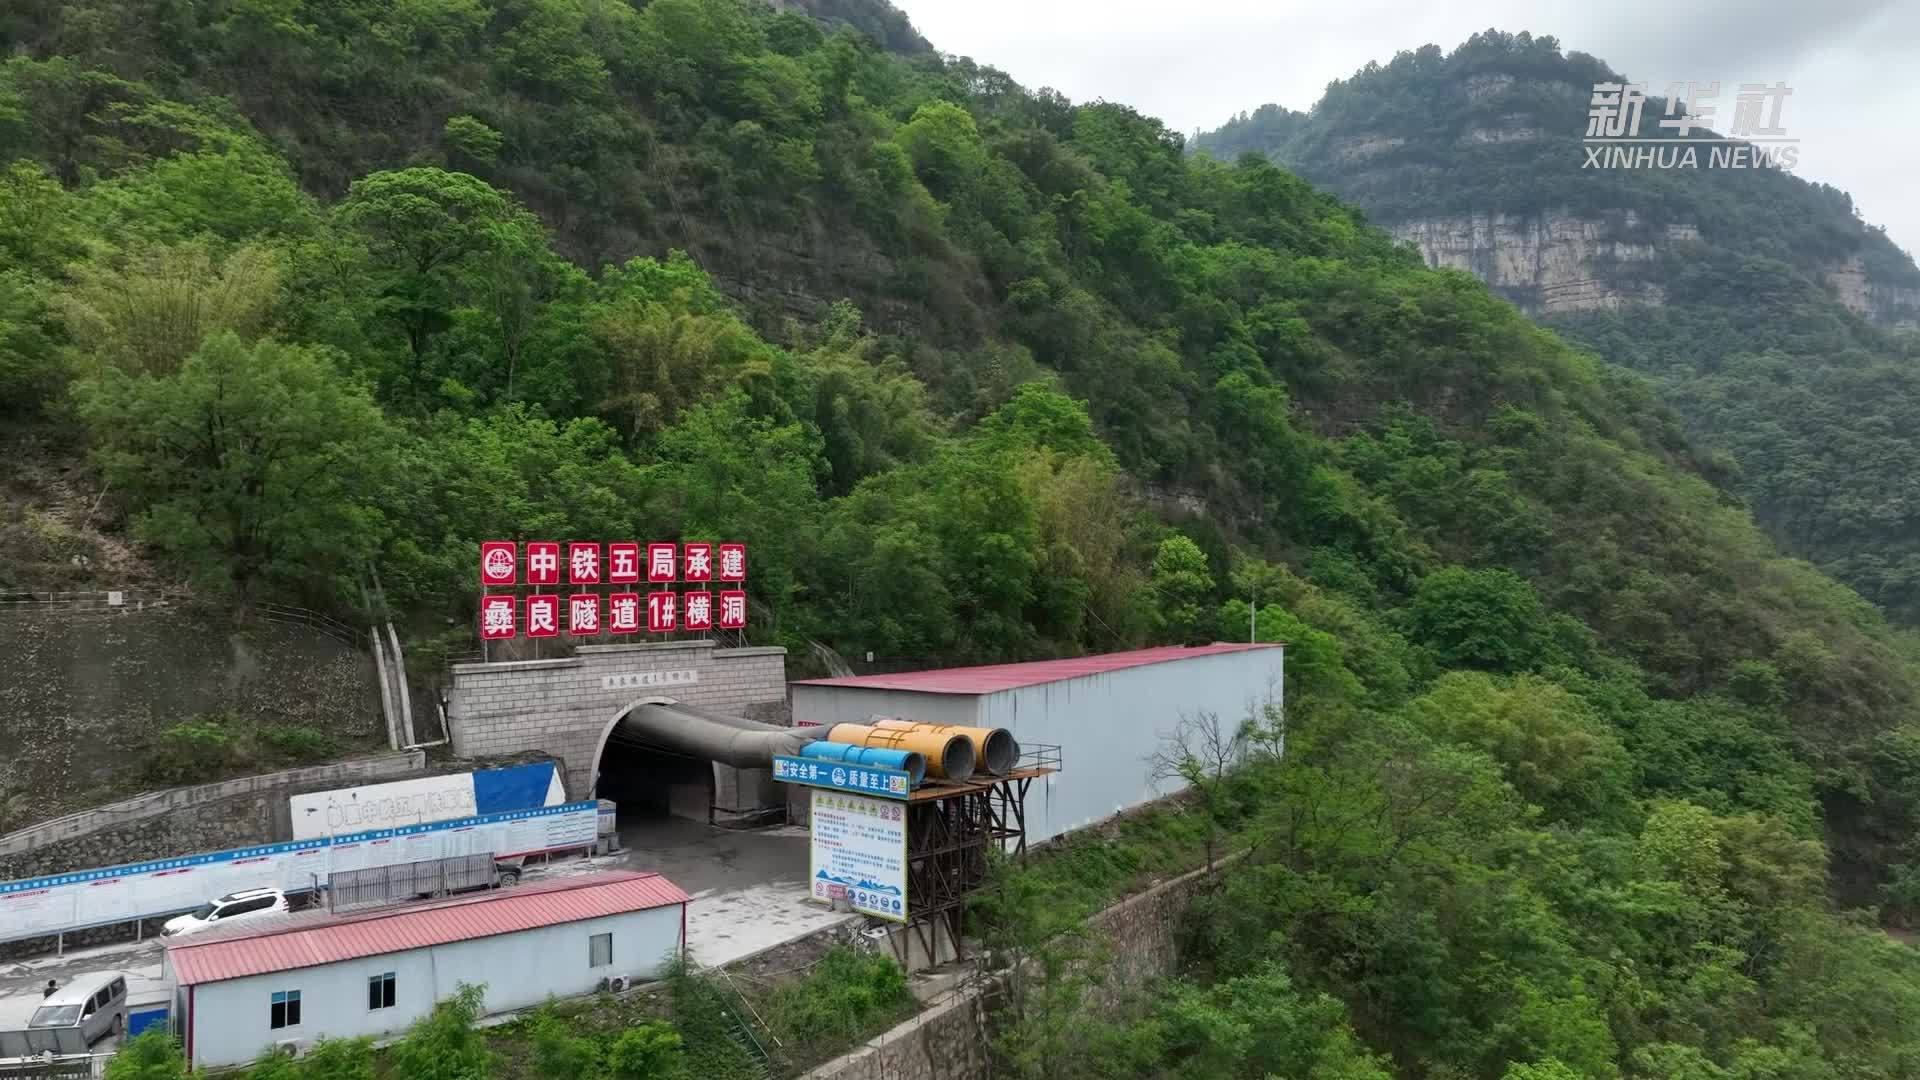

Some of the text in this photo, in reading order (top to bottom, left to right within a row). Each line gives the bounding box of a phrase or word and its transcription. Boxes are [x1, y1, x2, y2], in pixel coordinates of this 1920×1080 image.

[530, 547, 744, 580] 中铁五局承建
[484, 595, 744, 634] 彝良隧道1#横洞
[789, 762, 890, 791] 安全第一 质量至上
